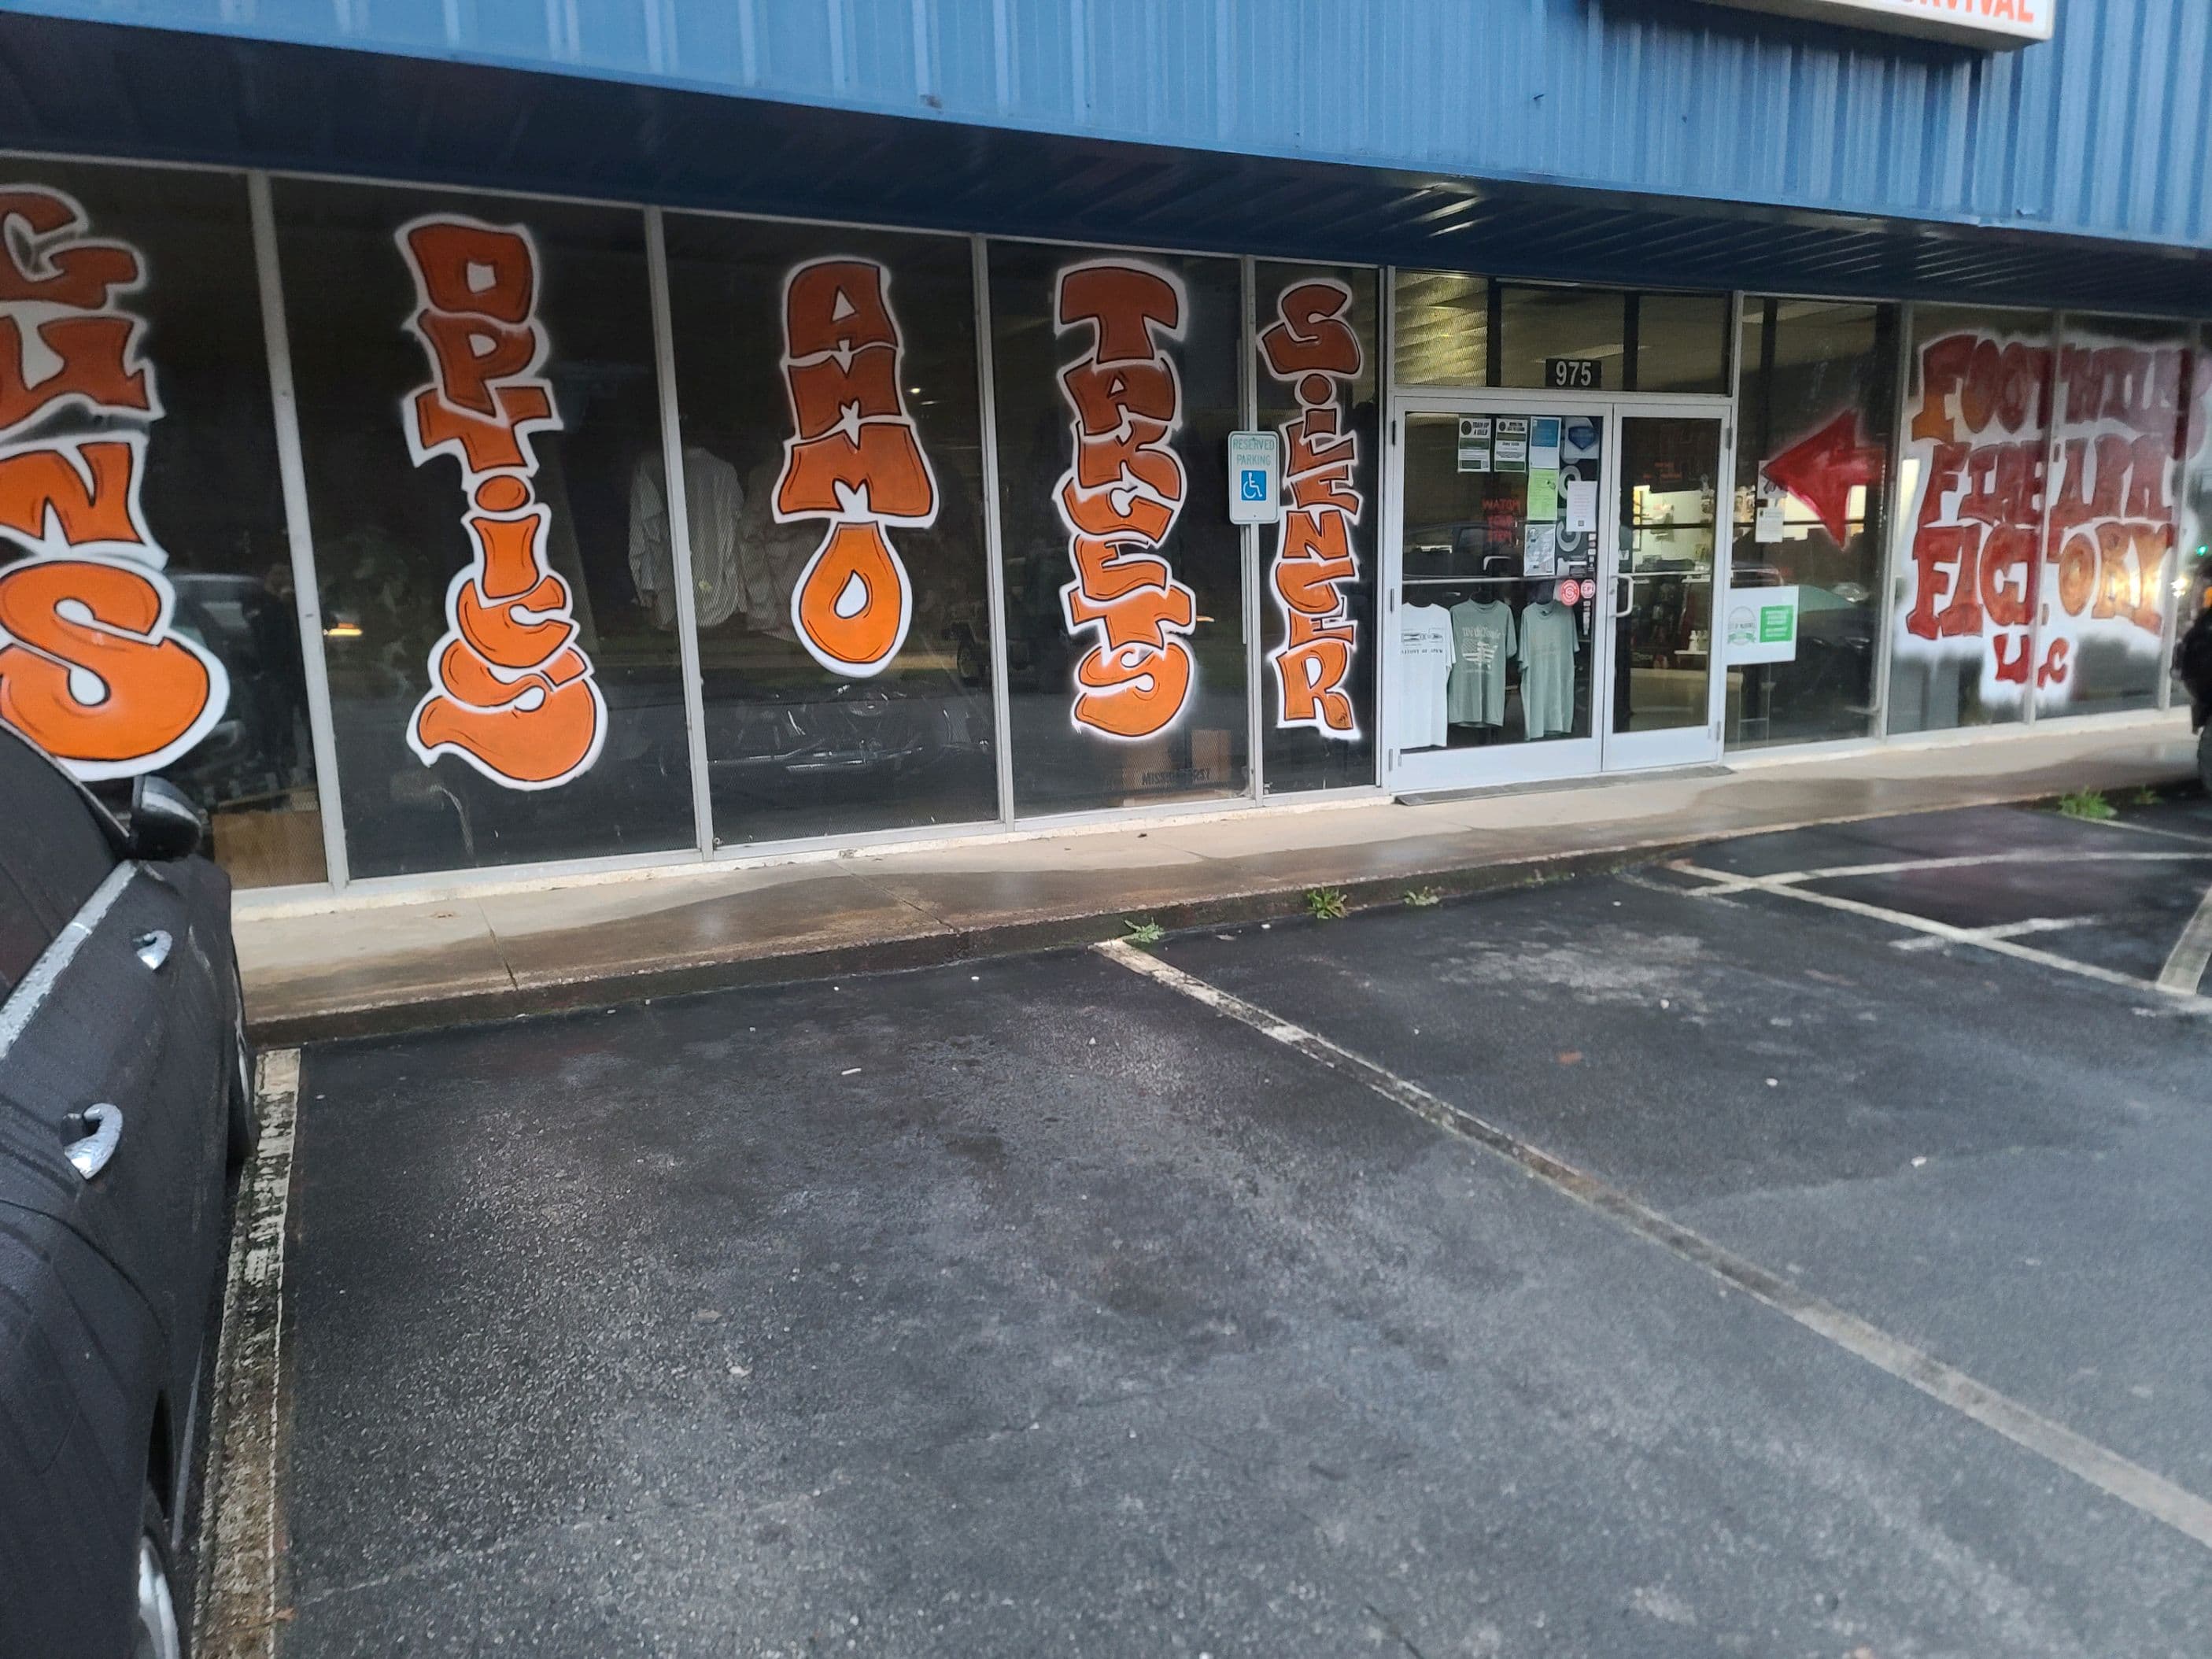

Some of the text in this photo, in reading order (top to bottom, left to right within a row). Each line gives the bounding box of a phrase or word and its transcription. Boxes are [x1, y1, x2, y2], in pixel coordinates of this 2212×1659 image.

[0, 187, 220, 768] GUNS
[777, 258, 936, 667] AMMO
[1233, 438, 1275, 450] RESERVED
[1236, 454, 1272, 466] PARKING
[1556, 360, 1592, 386] 975
[1059, 265, 1195, 738] TARGETS
